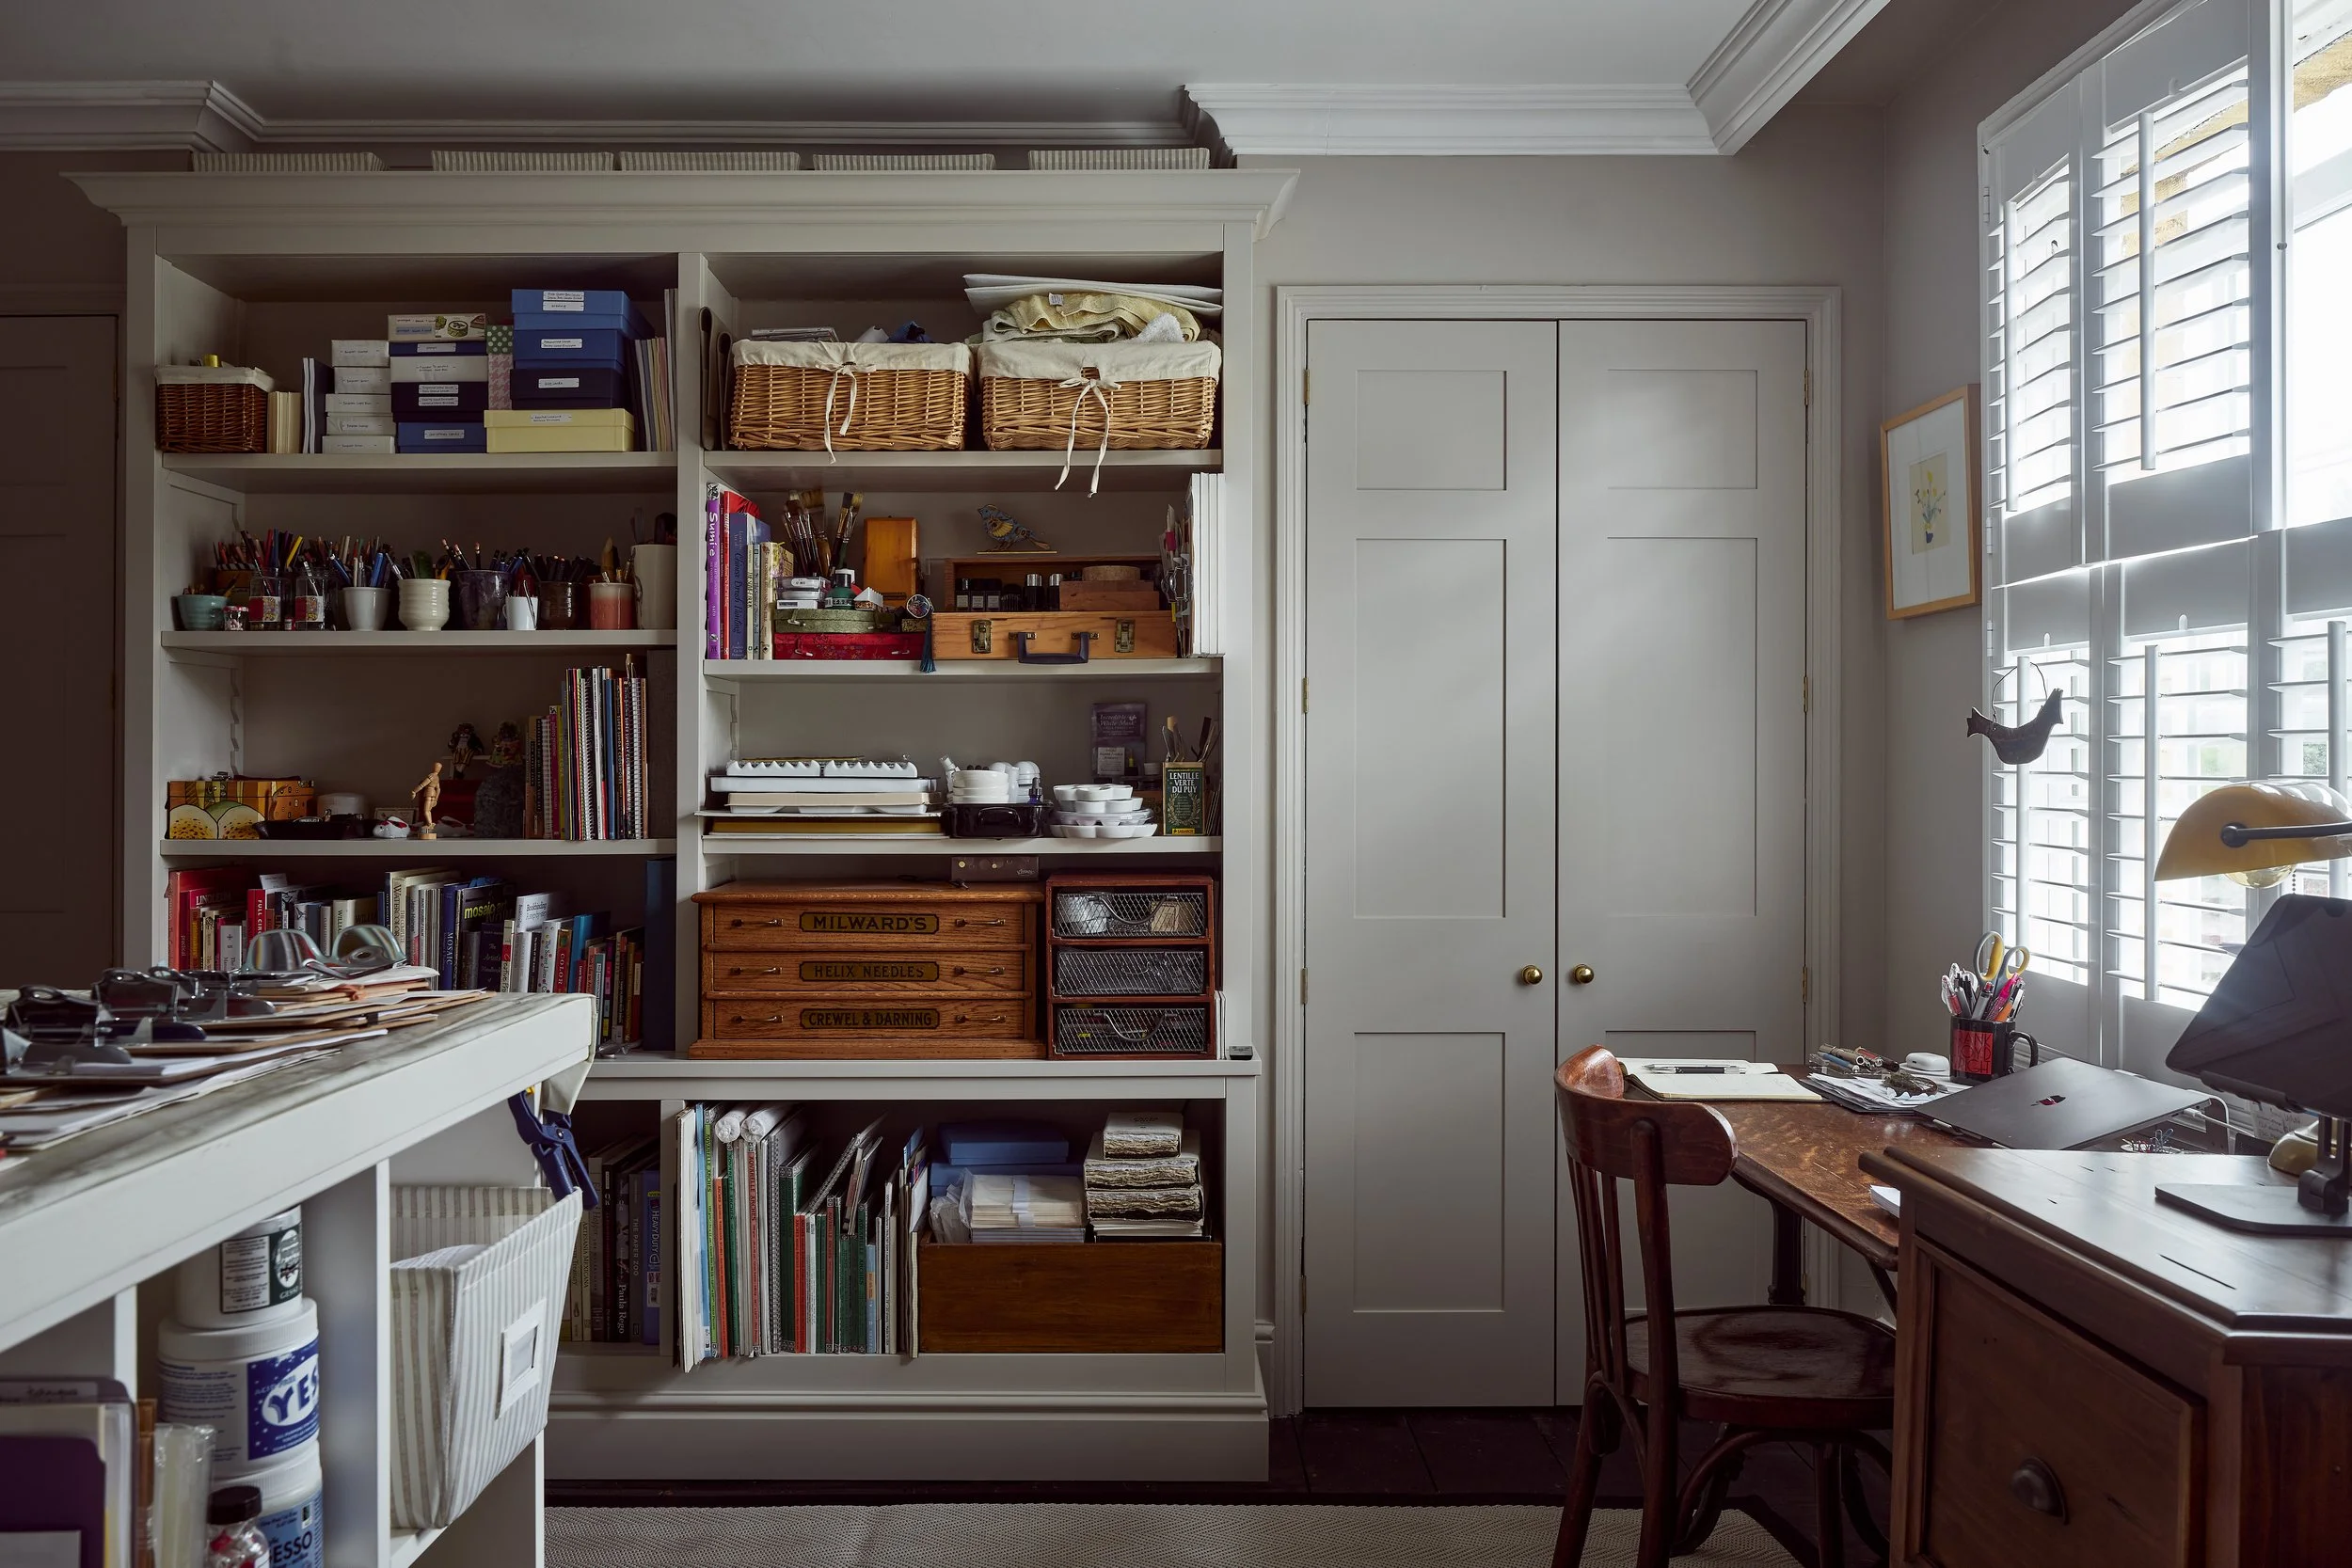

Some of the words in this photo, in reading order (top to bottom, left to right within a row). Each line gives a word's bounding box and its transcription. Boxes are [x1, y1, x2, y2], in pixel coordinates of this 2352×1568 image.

[708, 512, 718, 557] Sumi-e
[734, 553, 743, 578] Chinese
[734, 581, 743, 603] Brush
[733, 606, 743, 634] Painting
[464, 901, 496, 920] mosaic
[813, 916, 928, 930] MILWARD'S
[815, 965, 854, 978] HELIX
[863, 965, 924, 978] NEEDLES
[808, 1013, 859, 1026] CREWEL
[862, 1013, 871, 1025] &
[875, 1012, 932, 1026] DARNING
[618, 1284, 628, 1308] Paula
[616, 1311, 627, 1334] Rego
[269, 1530, 312, 1564] ESSO
